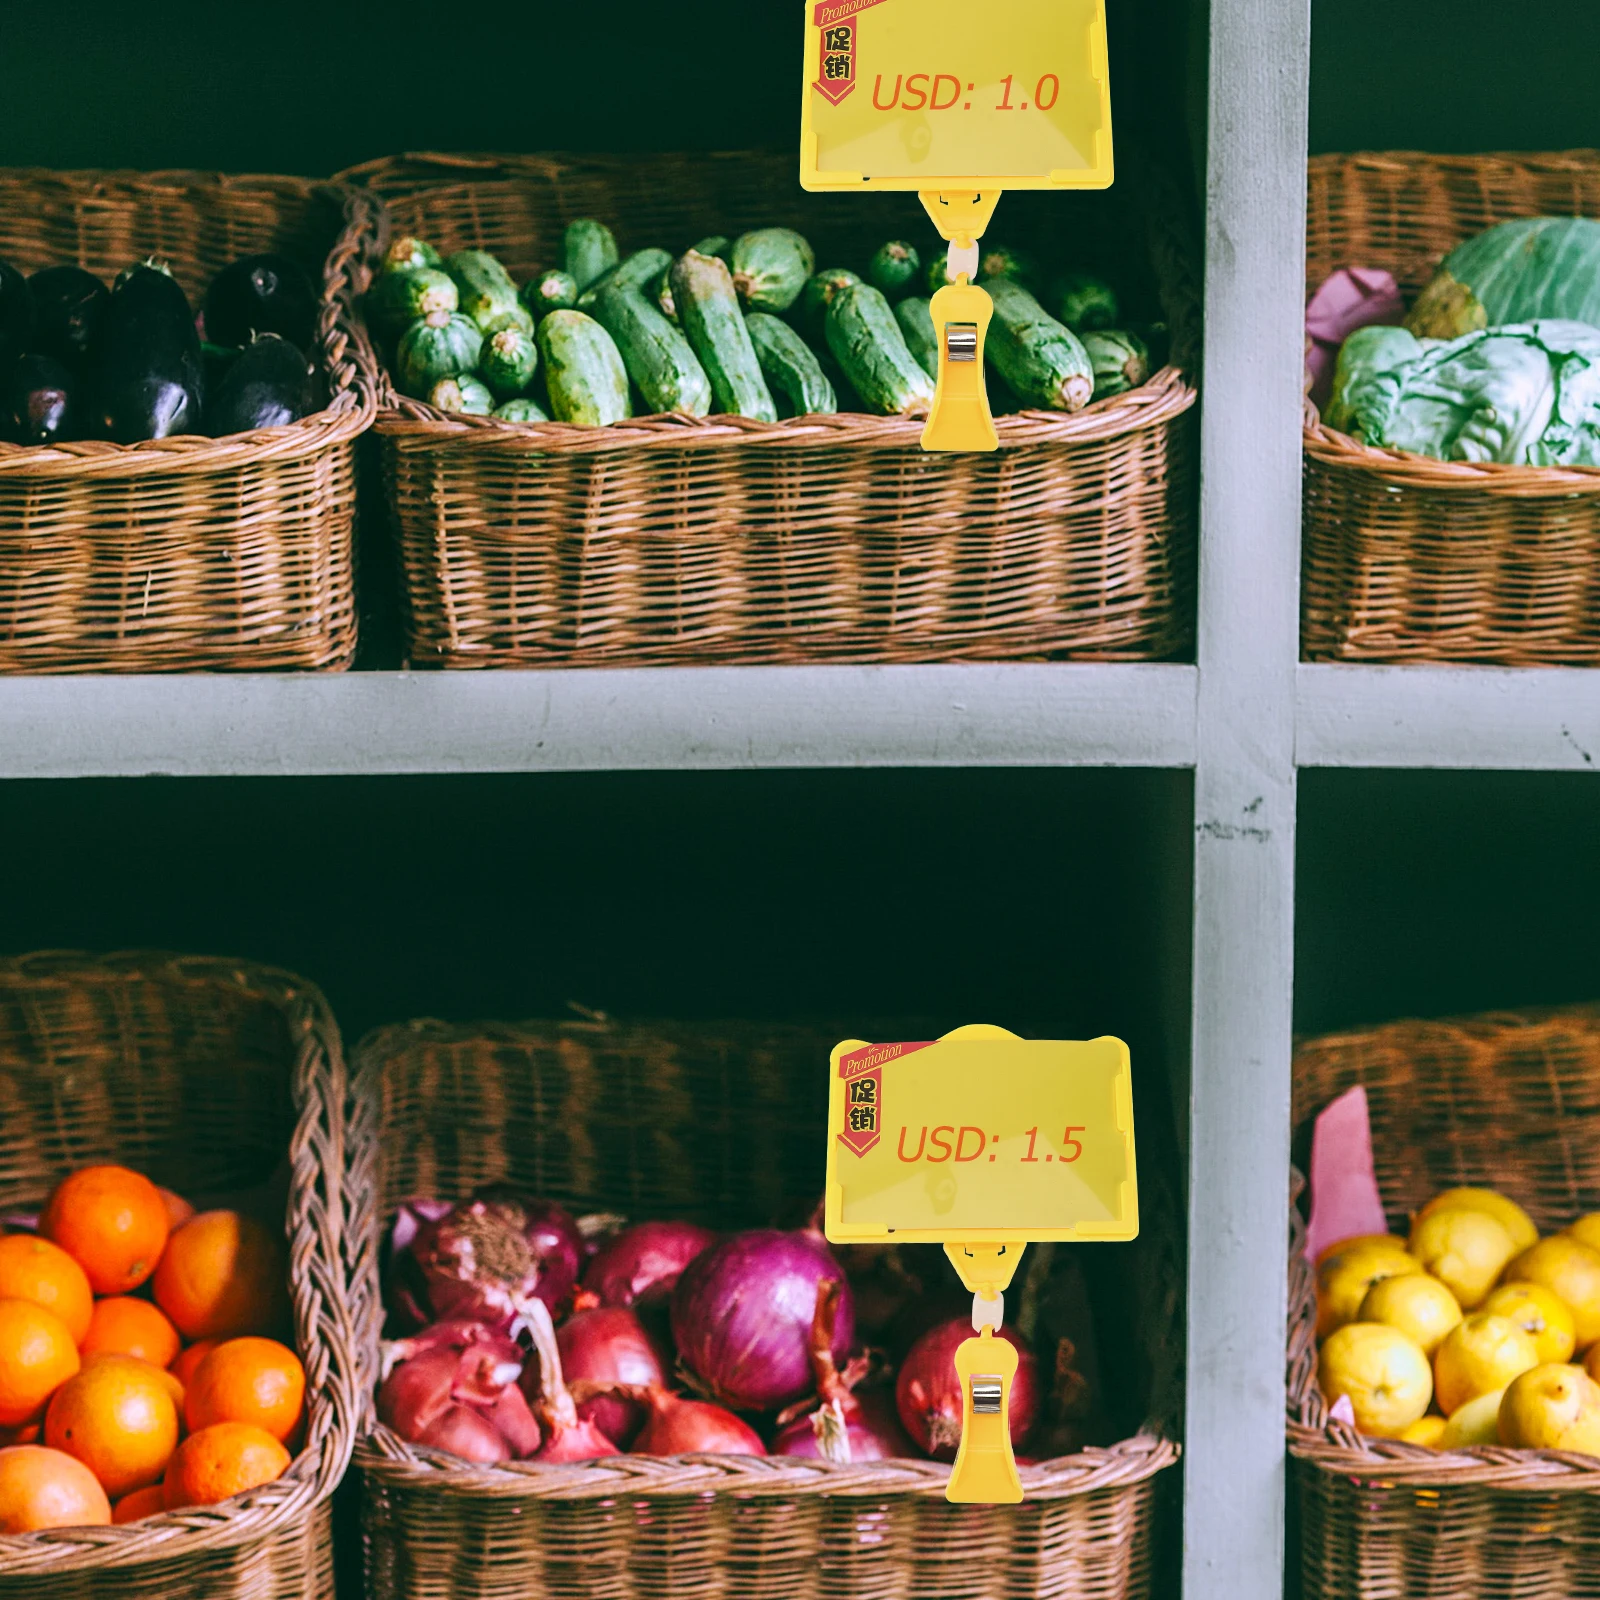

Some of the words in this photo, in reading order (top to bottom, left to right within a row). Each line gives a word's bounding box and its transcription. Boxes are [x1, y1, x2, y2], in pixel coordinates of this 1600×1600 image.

[823, 26, 852, 80] 促销
[872, 73, 975, 111] USD:
[995, 73, 1060, 111] 1.0
[844, 1043, 903, 1077] Promotion
[848, 1078, 877, 1132] 促销
[897, 1125, 1000, 1163] USD:
[1020, 1125, 1086, 1163] 1.5
